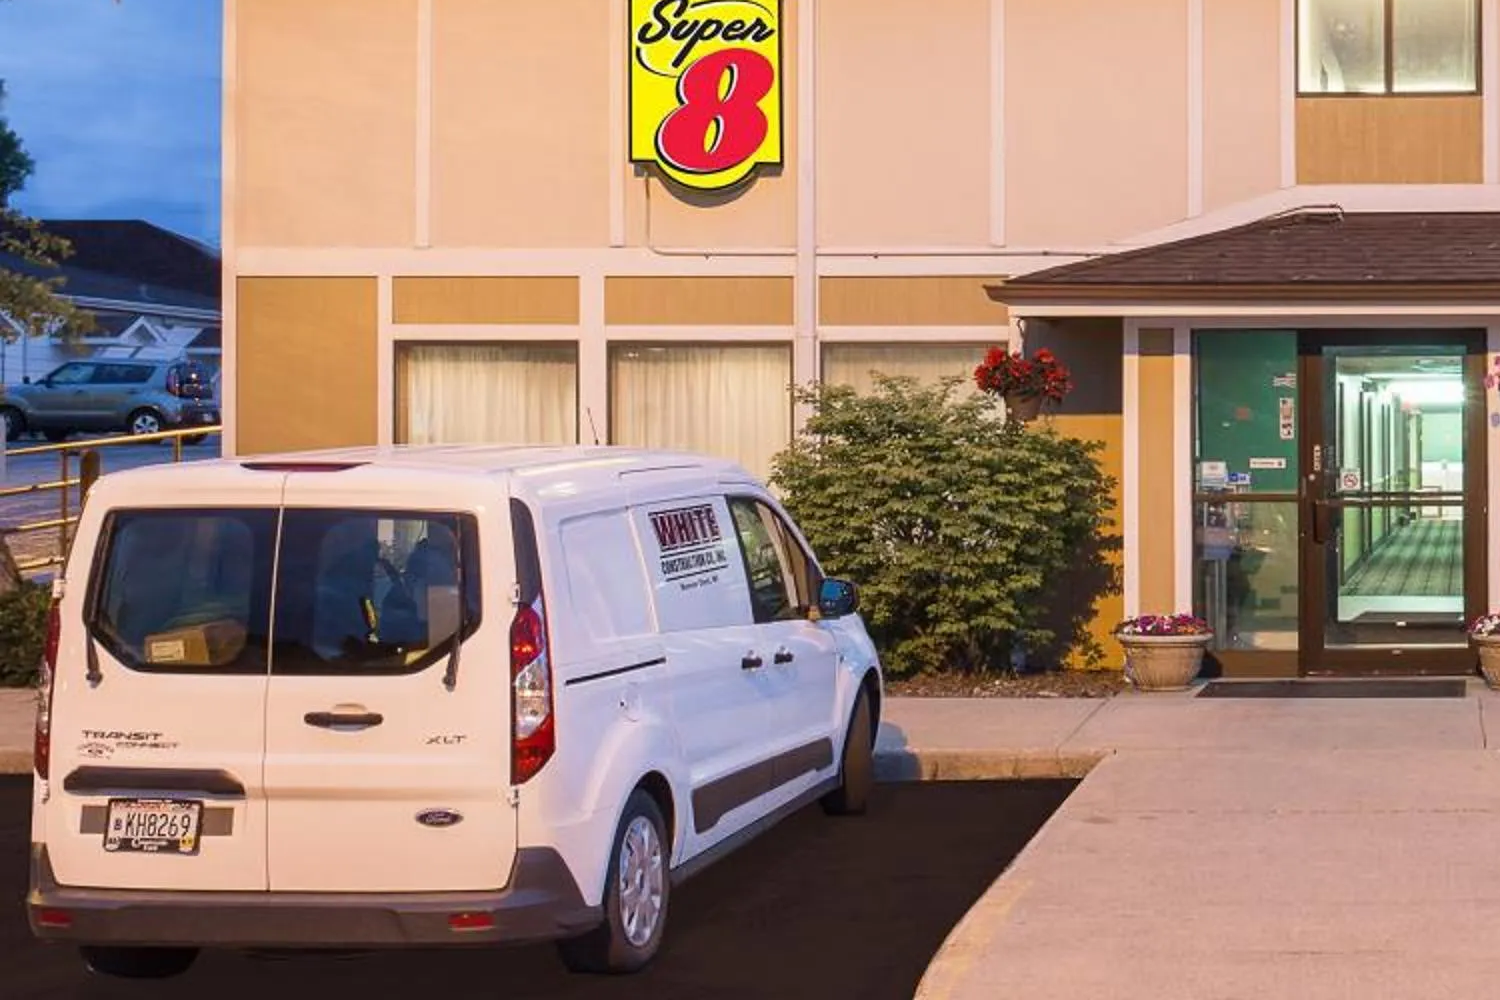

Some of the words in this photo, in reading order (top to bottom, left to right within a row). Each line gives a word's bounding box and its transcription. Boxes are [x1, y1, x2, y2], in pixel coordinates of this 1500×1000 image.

[654, 47, 775, 175] 8
[650, 507, 719, 548] WHITE
[82, 730, 163, 741] TRANSIT
[426, 735, 467, 745] XLT
[125, 812, 191, 838] KH8269
